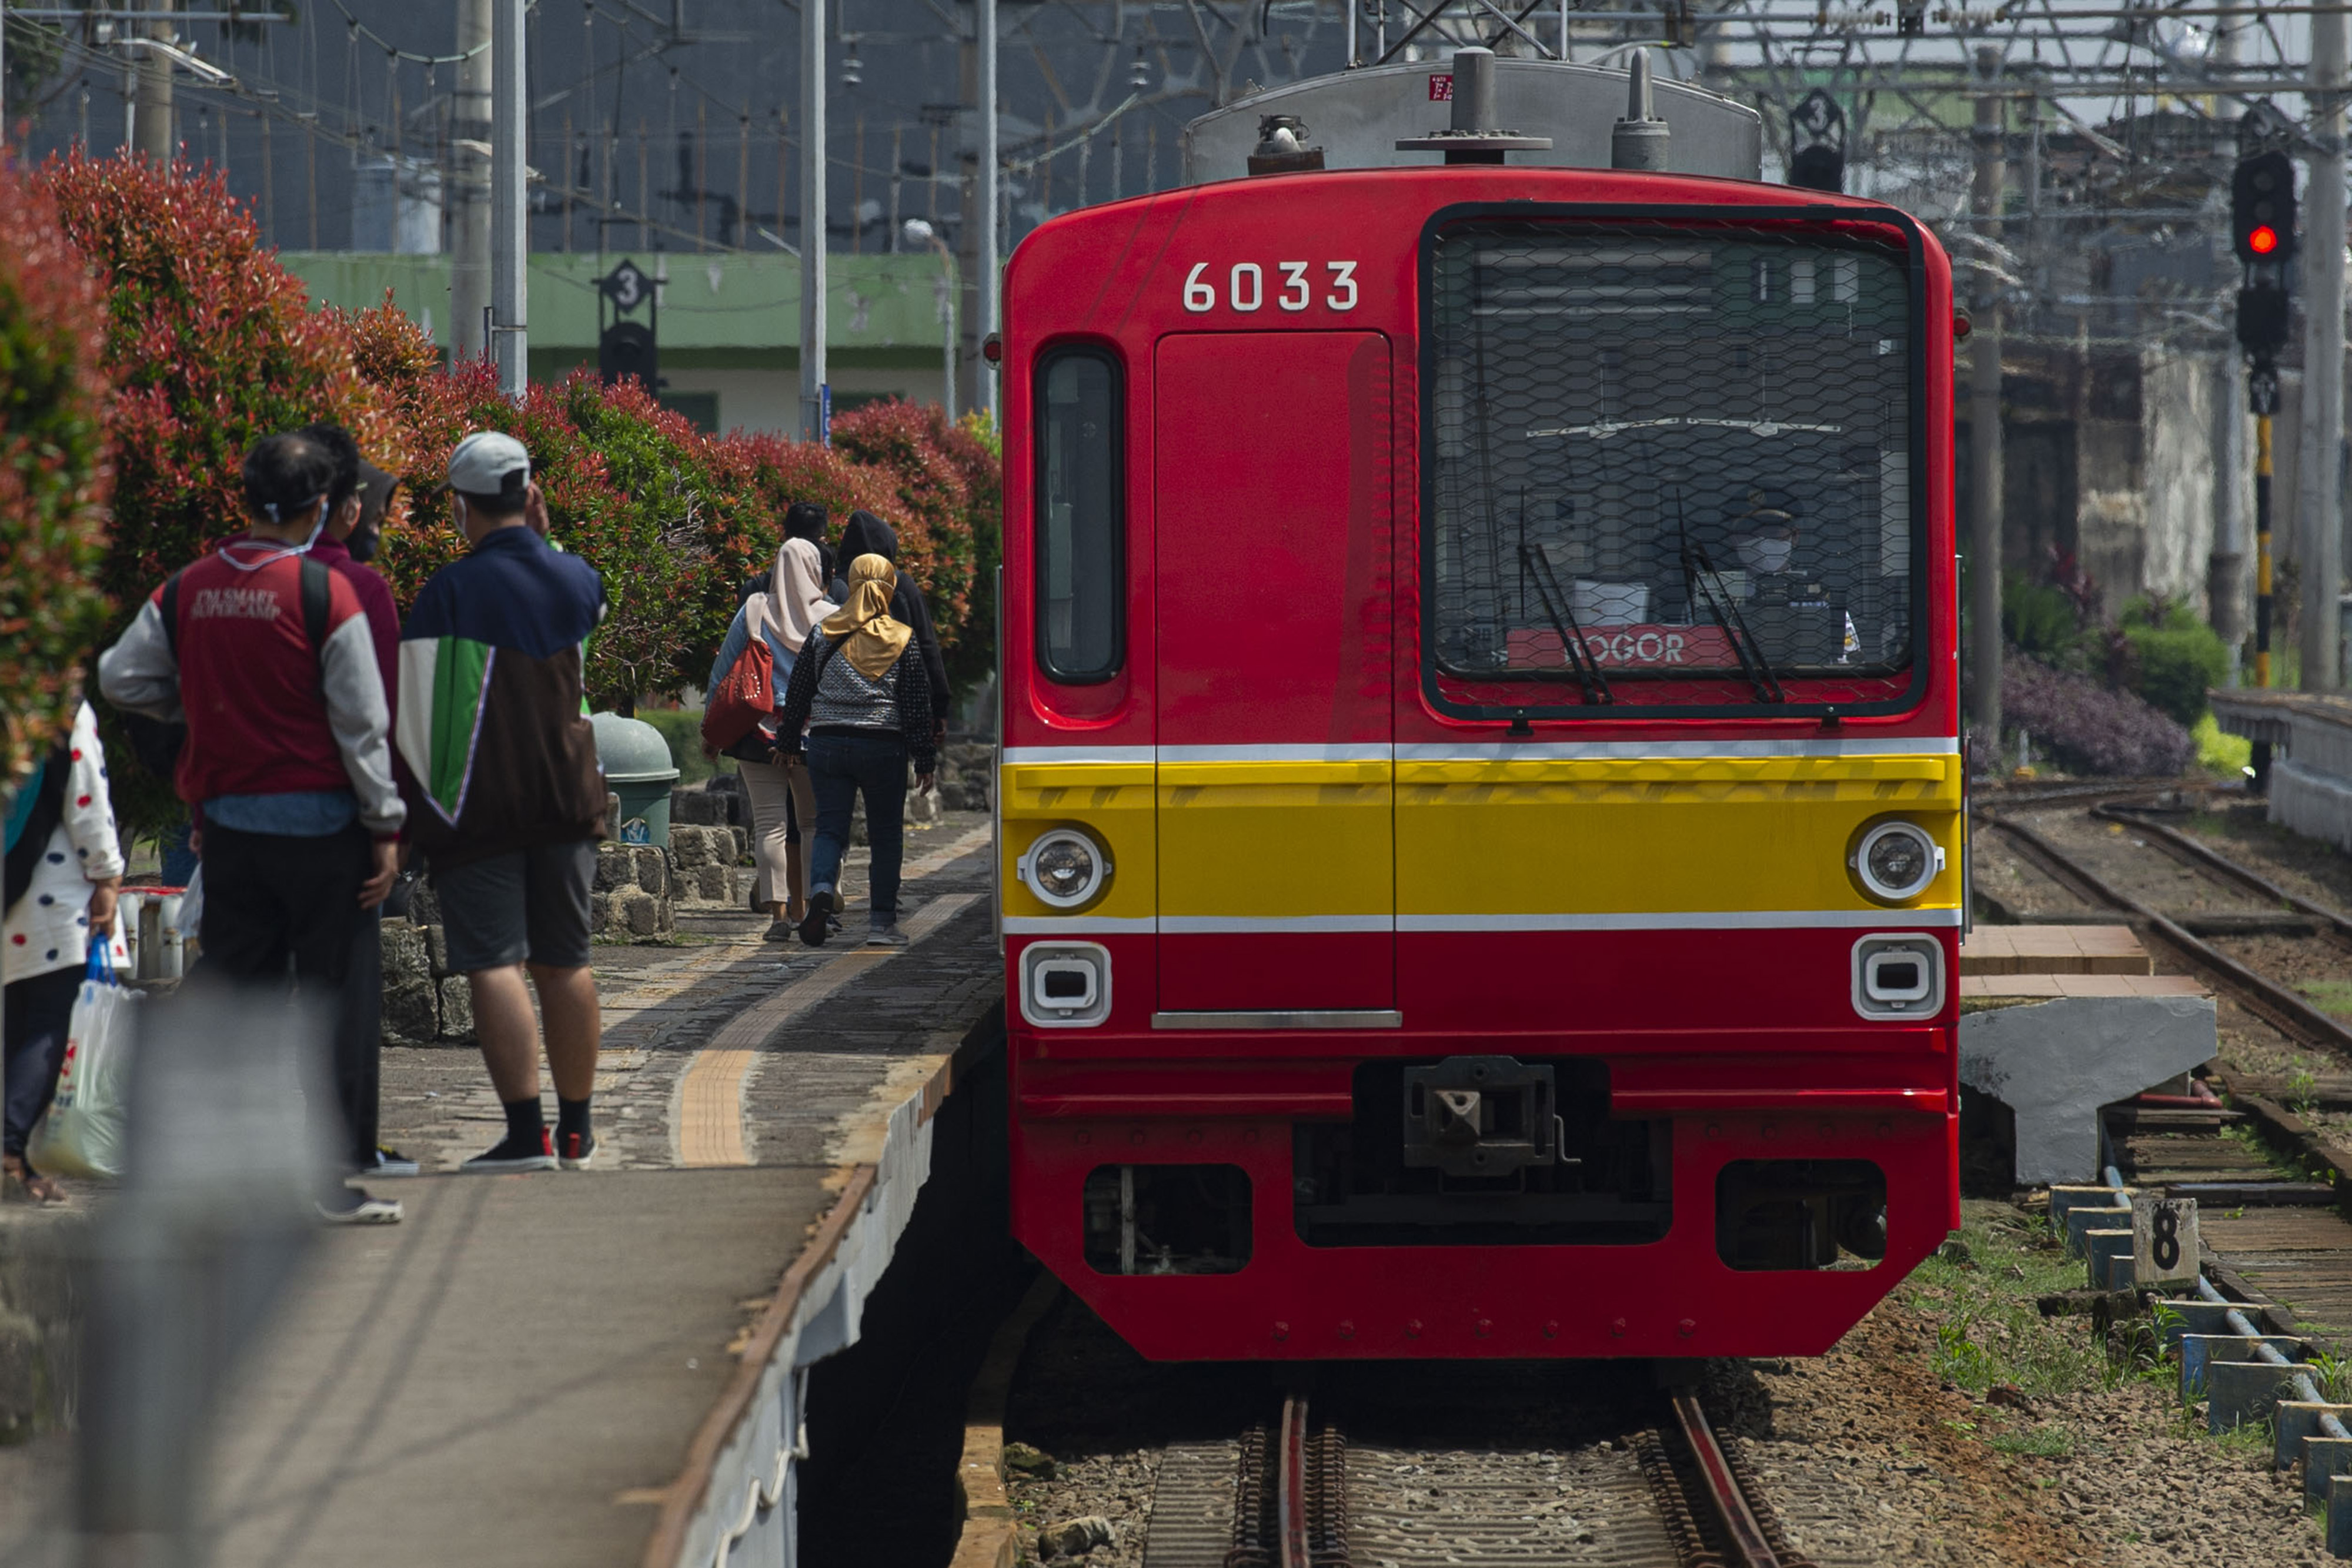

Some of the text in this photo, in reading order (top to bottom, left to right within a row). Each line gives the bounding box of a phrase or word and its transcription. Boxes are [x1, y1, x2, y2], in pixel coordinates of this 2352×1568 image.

[1808, 98, 1828, 130] 3
[616, 268, 638, 305] 3
[1184, 261, 1357, 311] 6033
[2153, 1206, 2180, 1271] 8
